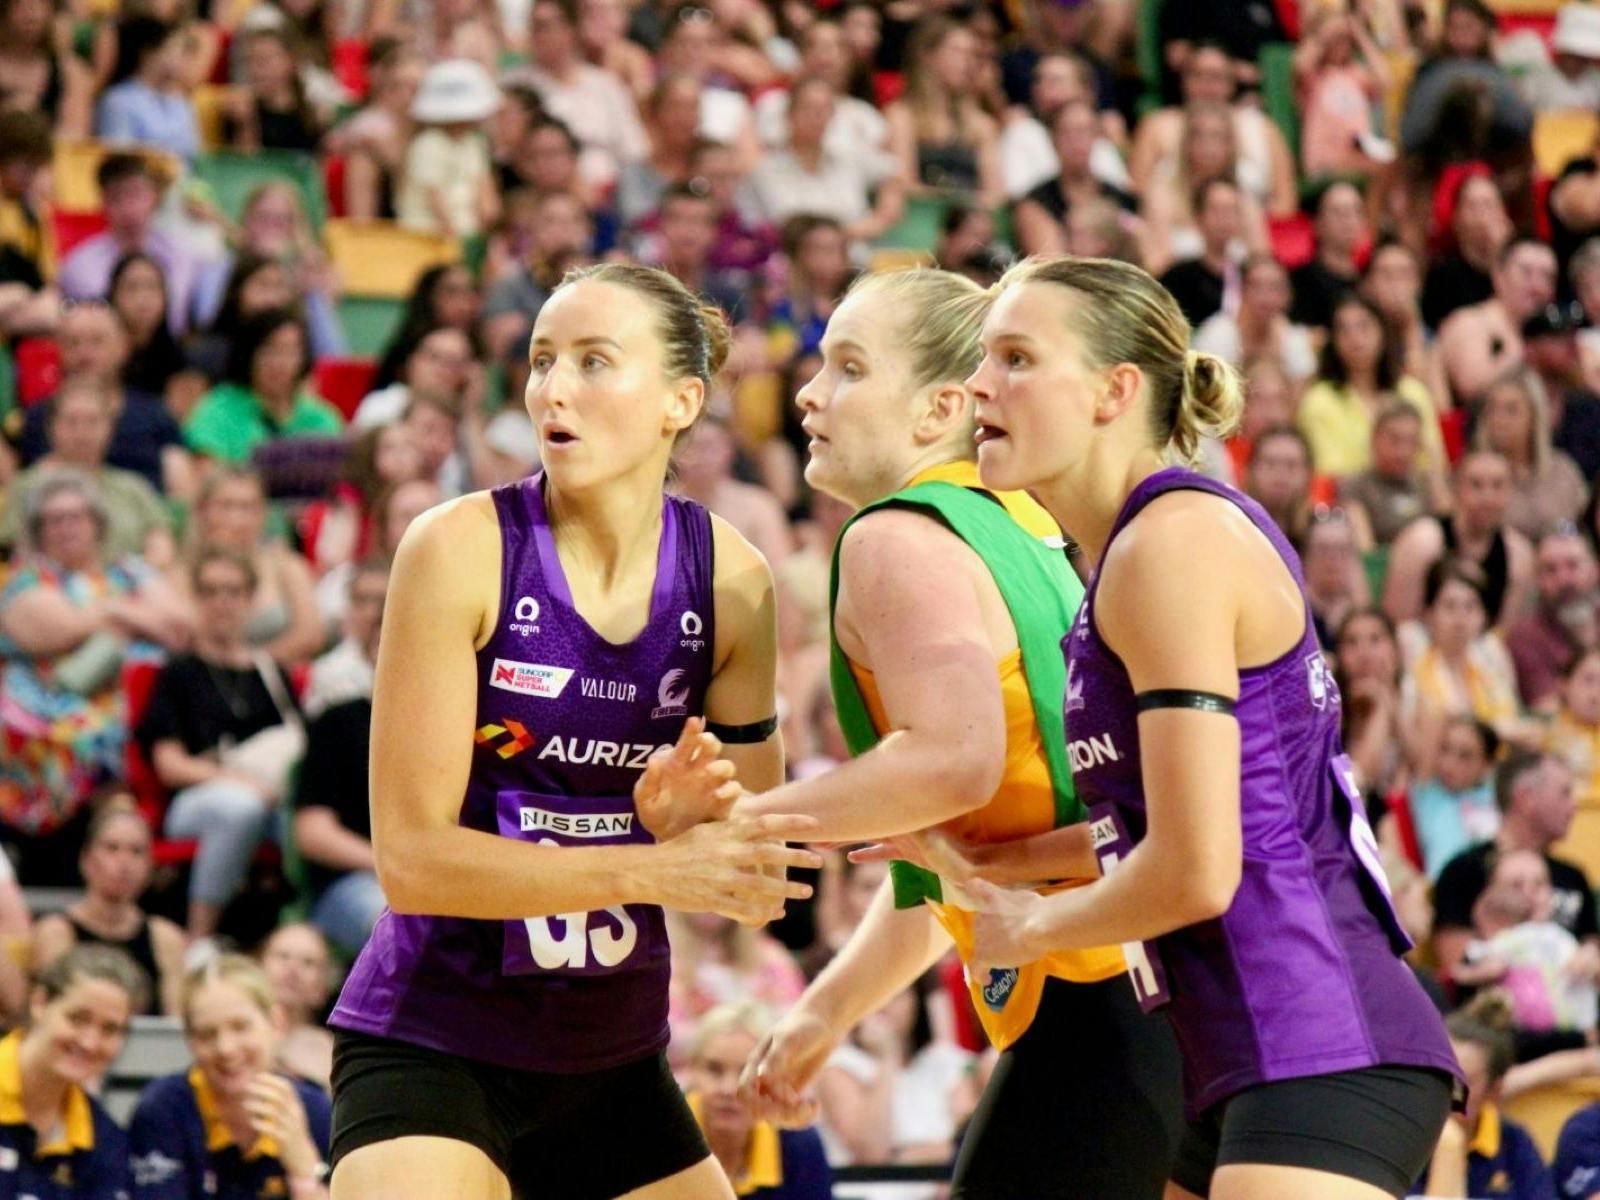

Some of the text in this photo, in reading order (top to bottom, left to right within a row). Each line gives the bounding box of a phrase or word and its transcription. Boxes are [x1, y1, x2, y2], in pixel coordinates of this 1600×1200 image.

[509, 623, 540, 637] origin
[680, 639, 705, 652] origin
[516, 674, 543, 684] SUPER
[514, 681, 551, 693] NETBALL
[581, 677, 637, 703] VALOUR
[522, 810, 632, 833] NISSAN
